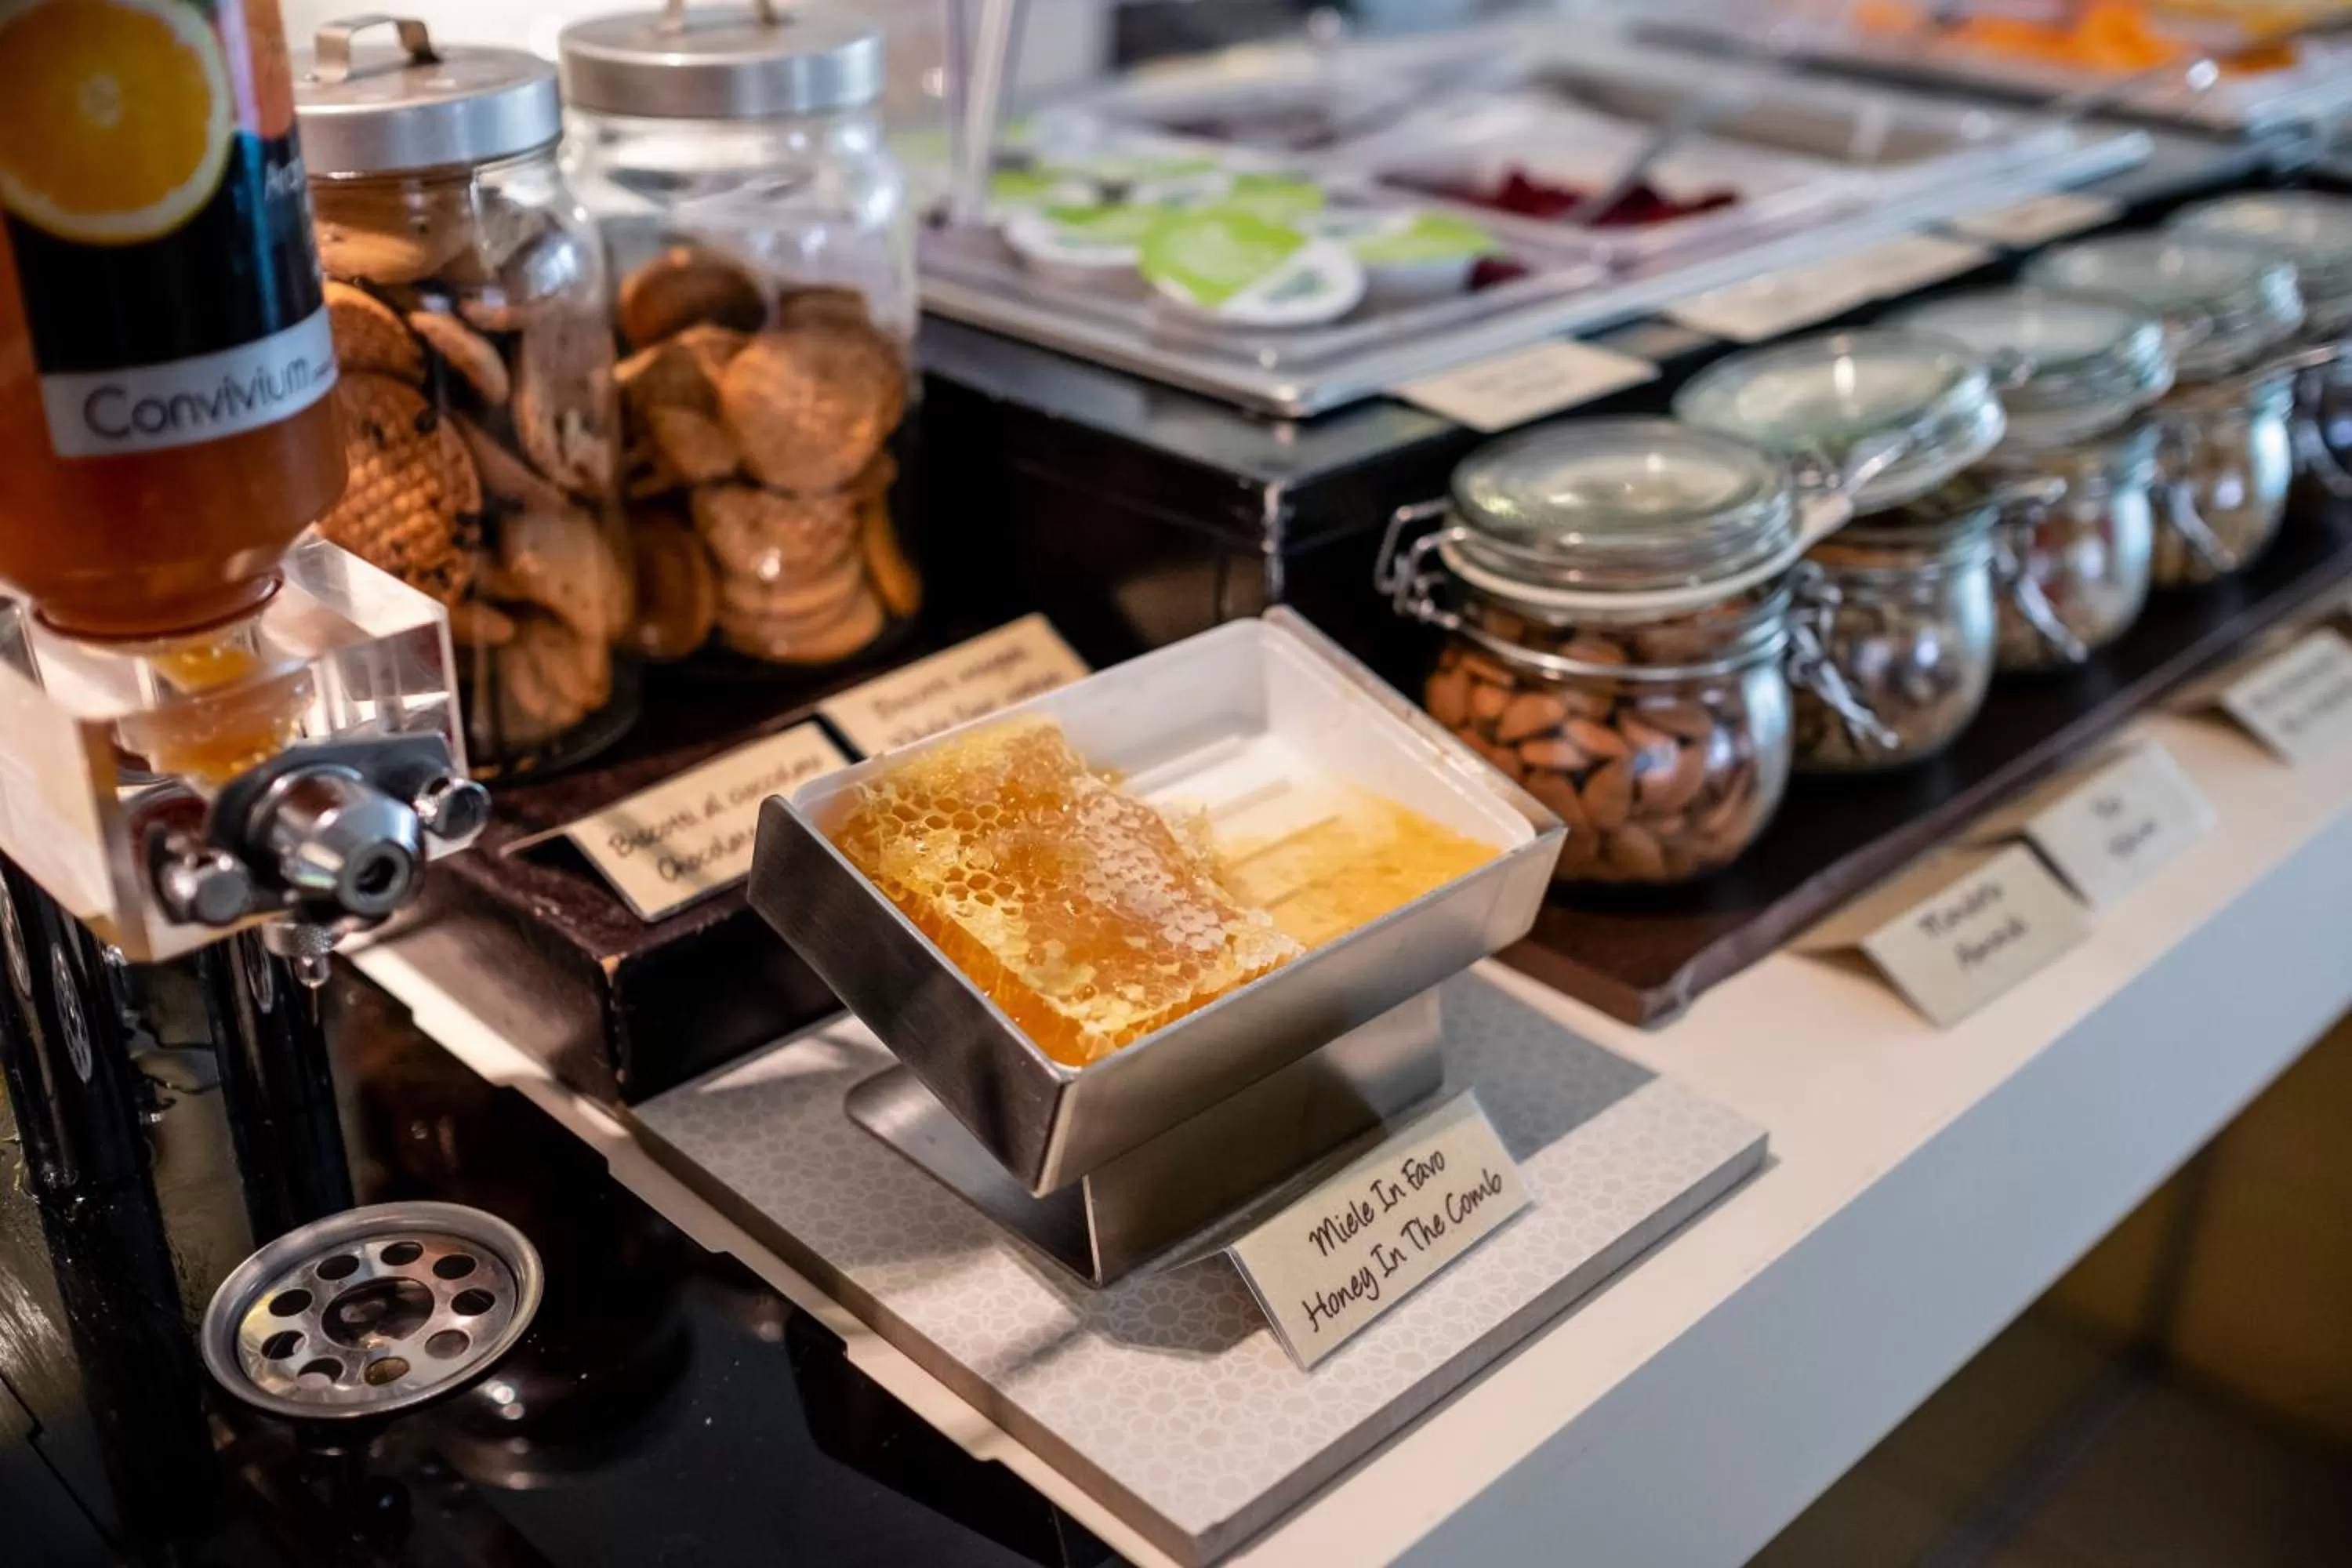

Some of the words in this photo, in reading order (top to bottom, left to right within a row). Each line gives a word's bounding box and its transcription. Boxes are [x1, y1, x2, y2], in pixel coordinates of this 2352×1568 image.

[83, 357, 310, 440] Convivium
[1301, 1265, 1380, 1333] Honey
[1370, 1243, 1406, 1279] In
[1400, 1214, 1445, 1252] The
[1445, 1168, 1503, 1225] Comb
[1308, 1199, 1375, 1257] Miele
[1370, 1178, 1406, 1213] In
[1401, 1150, 1446, 1190] Favo
